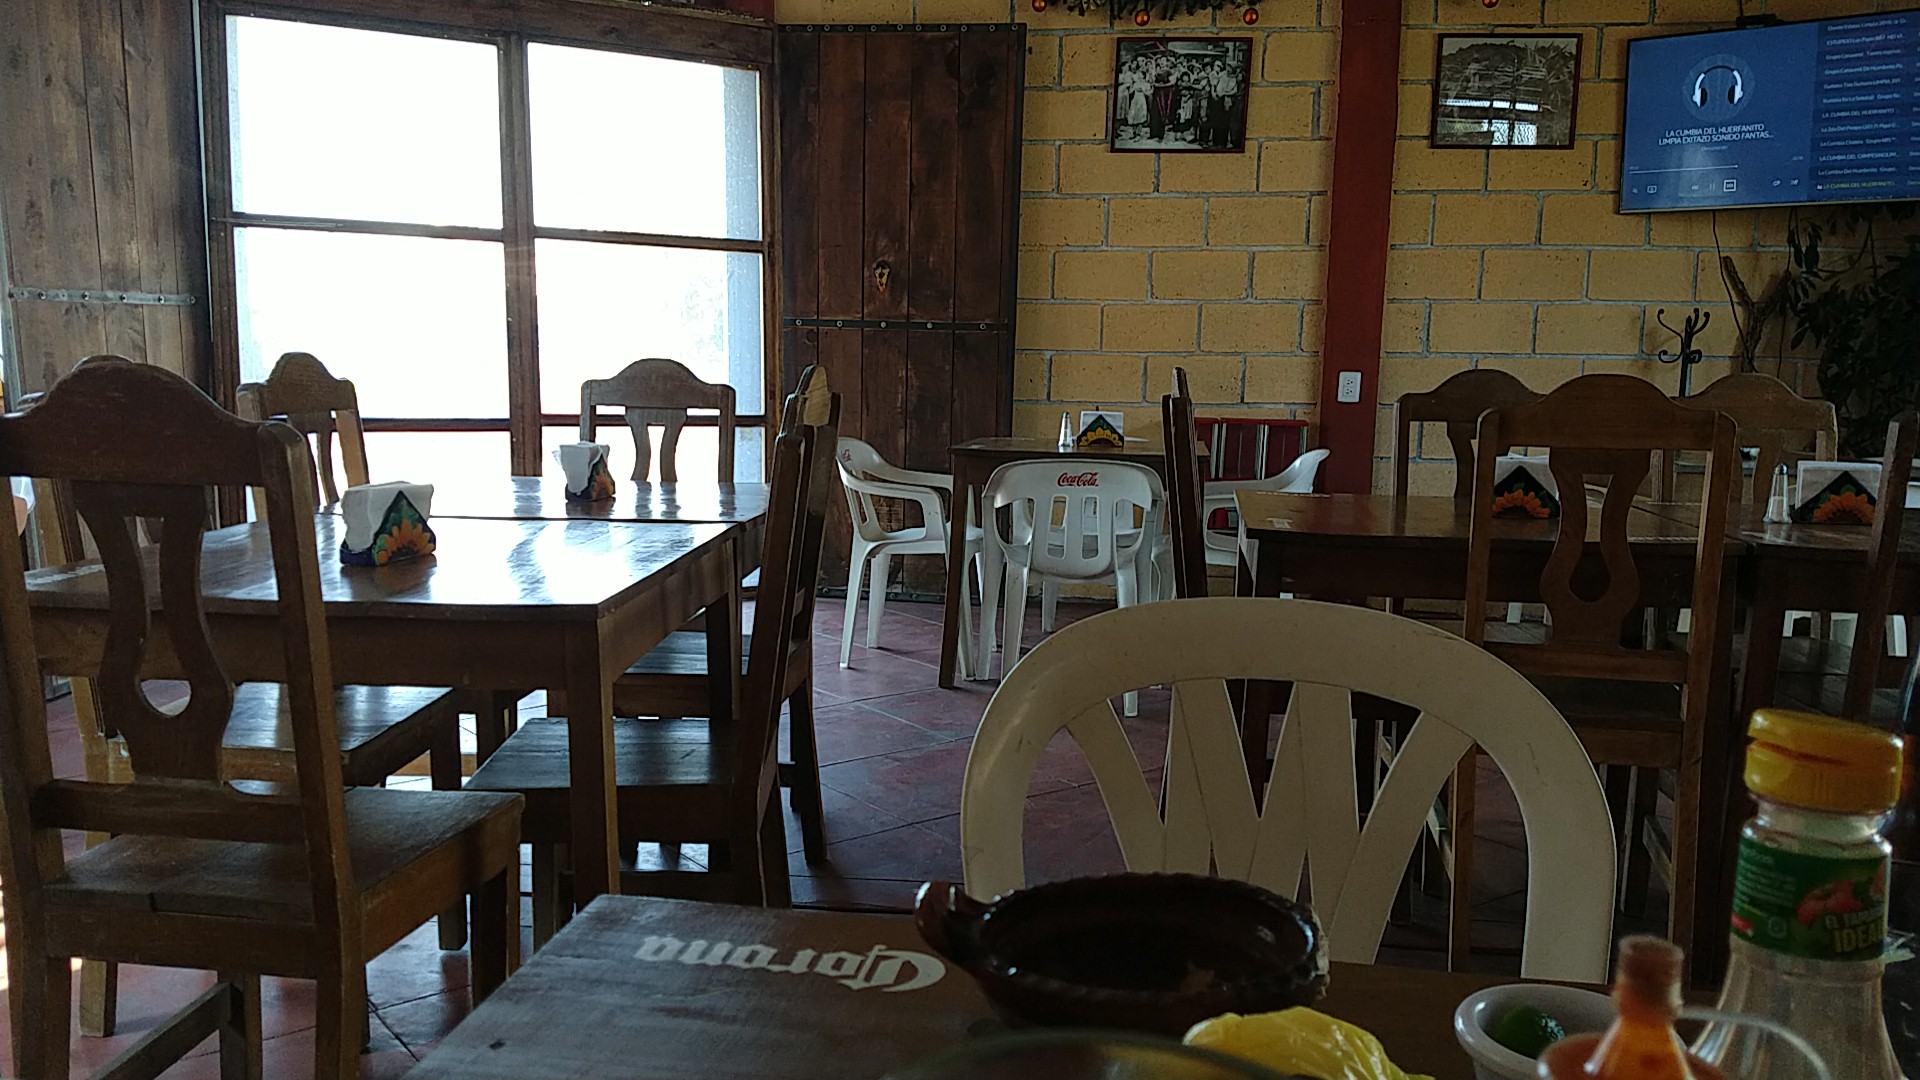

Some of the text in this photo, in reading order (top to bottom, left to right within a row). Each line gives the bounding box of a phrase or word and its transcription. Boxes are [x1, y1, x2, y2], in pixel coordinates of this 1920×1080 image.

[1666, 123, 1765, 138] LA CUMBIA DEL HUERFANITO
[1658, 137, 1682, 146] LIMPIA
[1682, 135, 1711, 145] EXITAZO
[1711, 132, 1740, 142] SONIDO
[633, 934, 946, 992] Corona
